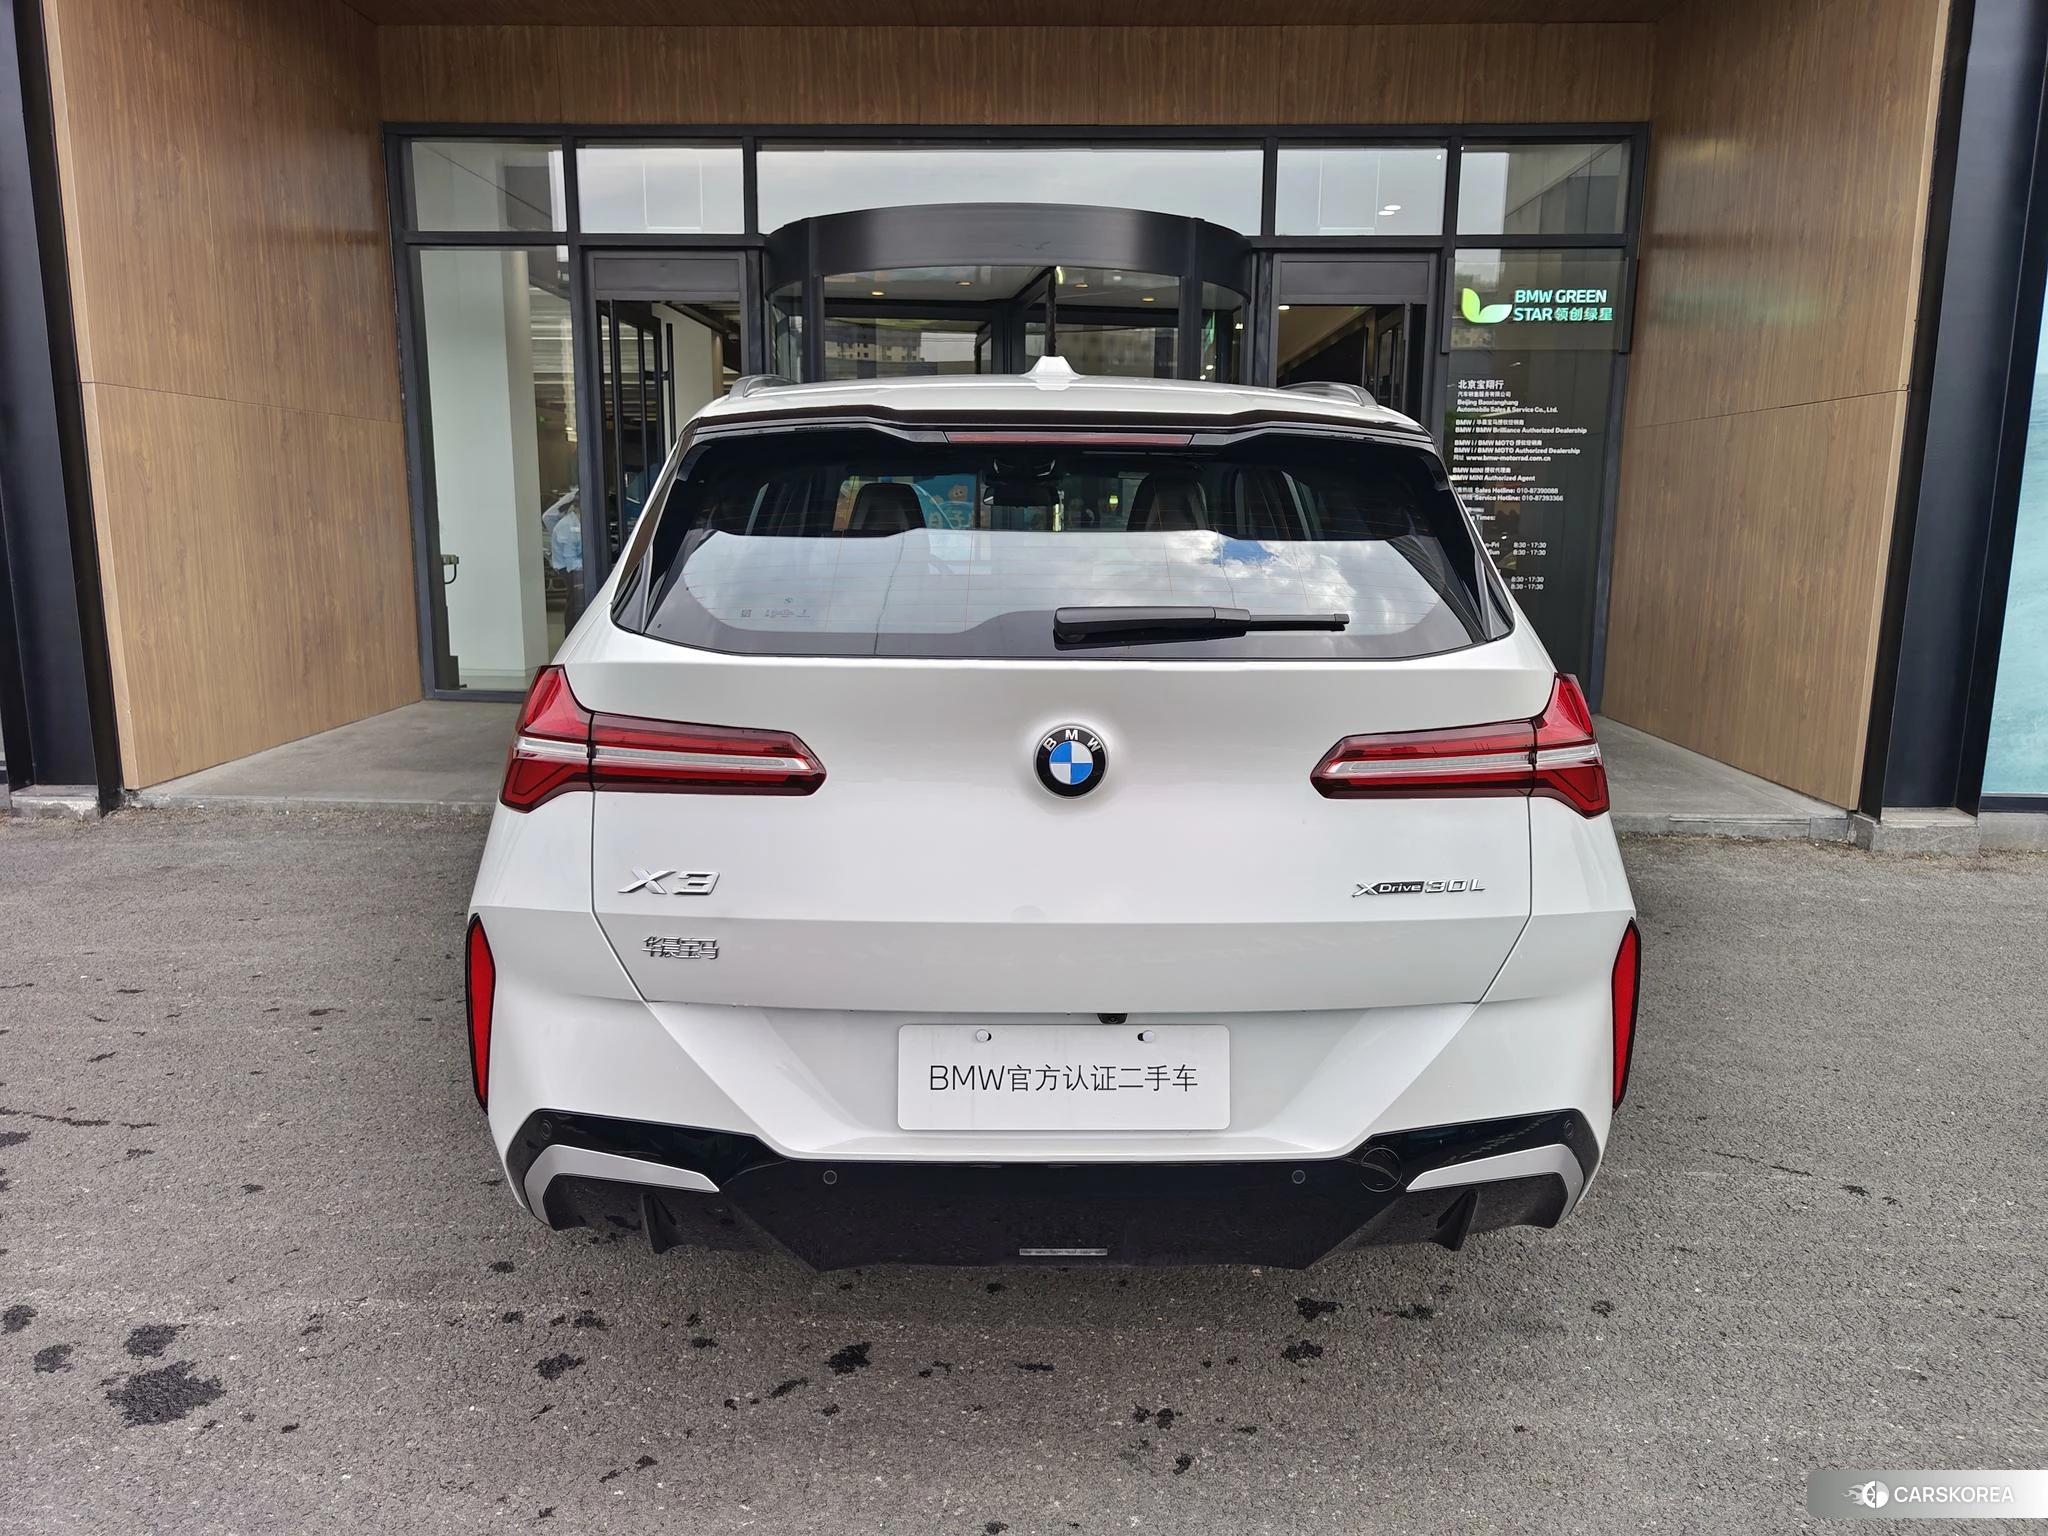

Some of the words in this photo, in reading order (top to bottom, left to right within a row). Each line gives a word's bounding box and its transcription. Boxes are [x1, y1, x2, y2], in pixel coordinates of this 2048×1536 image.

[1514, 289, 1553, 303] BMW
[1555, 289, 1608, 303] GREEN
[1512, 307, 1552, 322] STAR
[1554, 307, 1613, 322] 领创绿星
[1458, 380, 1504, 390] 北京宝翔行
[1457, 399, 1478, 407] Beijing
[1555, 427, 1587, 435] Dealership
[1042, 729, 1101, 752] BMW
[617, 866, 721, 896] X3
[641, 935, 721, 960] 华晨宝马
[929, 1063, 1199, 1093] BMW官方认证二手车
